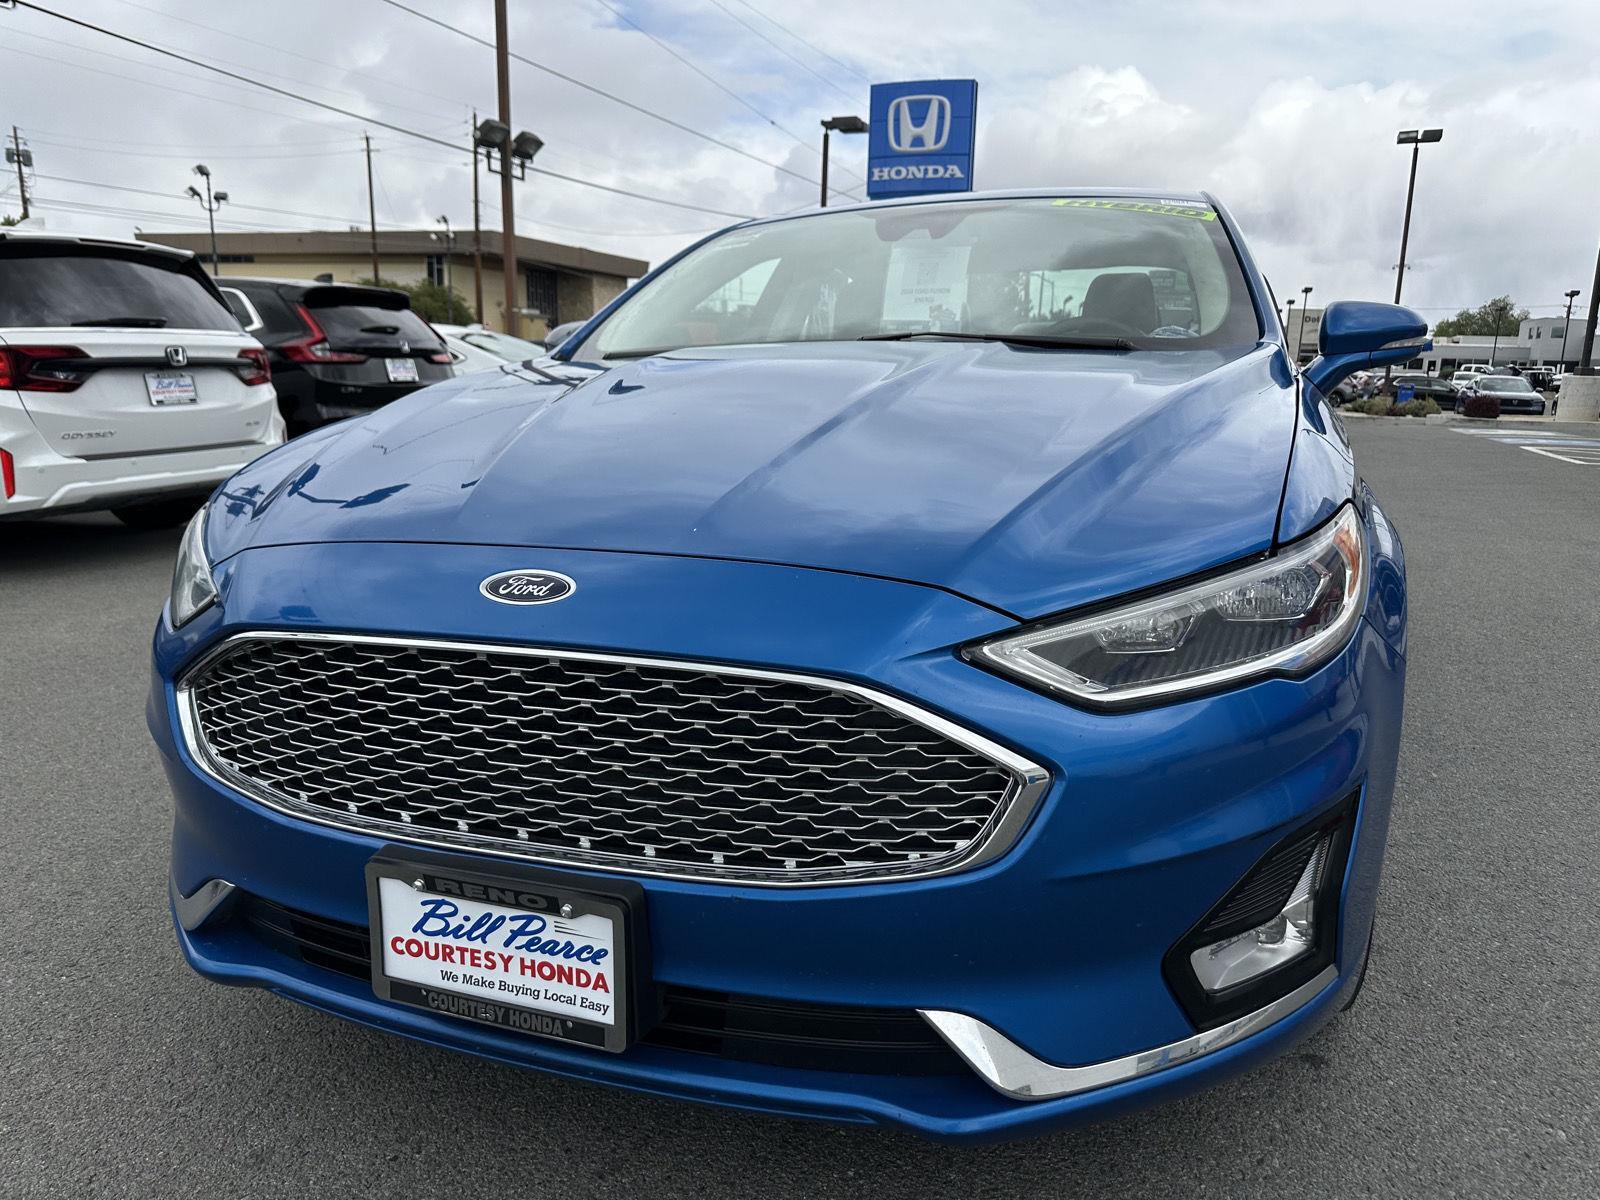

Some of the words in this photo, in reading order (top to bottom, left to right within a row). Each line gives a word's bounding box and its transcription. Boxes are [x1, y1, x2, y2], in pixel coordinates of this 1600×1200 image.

[872, 165, 964, 181] HONDA
[499, 575, 555, 597] Ford
[434, 878, 549, 909] RENO
[412, 899, 507, 944] Bill
[503, 913, 609, 966] Pearce
[391, 936, 514, 973] COURTESY
[519, 957, 610, 994] HONDA
[428, 992, 506, 1024] COURTESY
[509, 1009, 564, 1036] HONDA
[440, 970, 459, 983] We
[462, 974, 495, 989] Make
[498, 980, 540, 1000] Buying
[544, 989, 576, 1006] Local
[579, 997, 610, 1015] Easy
